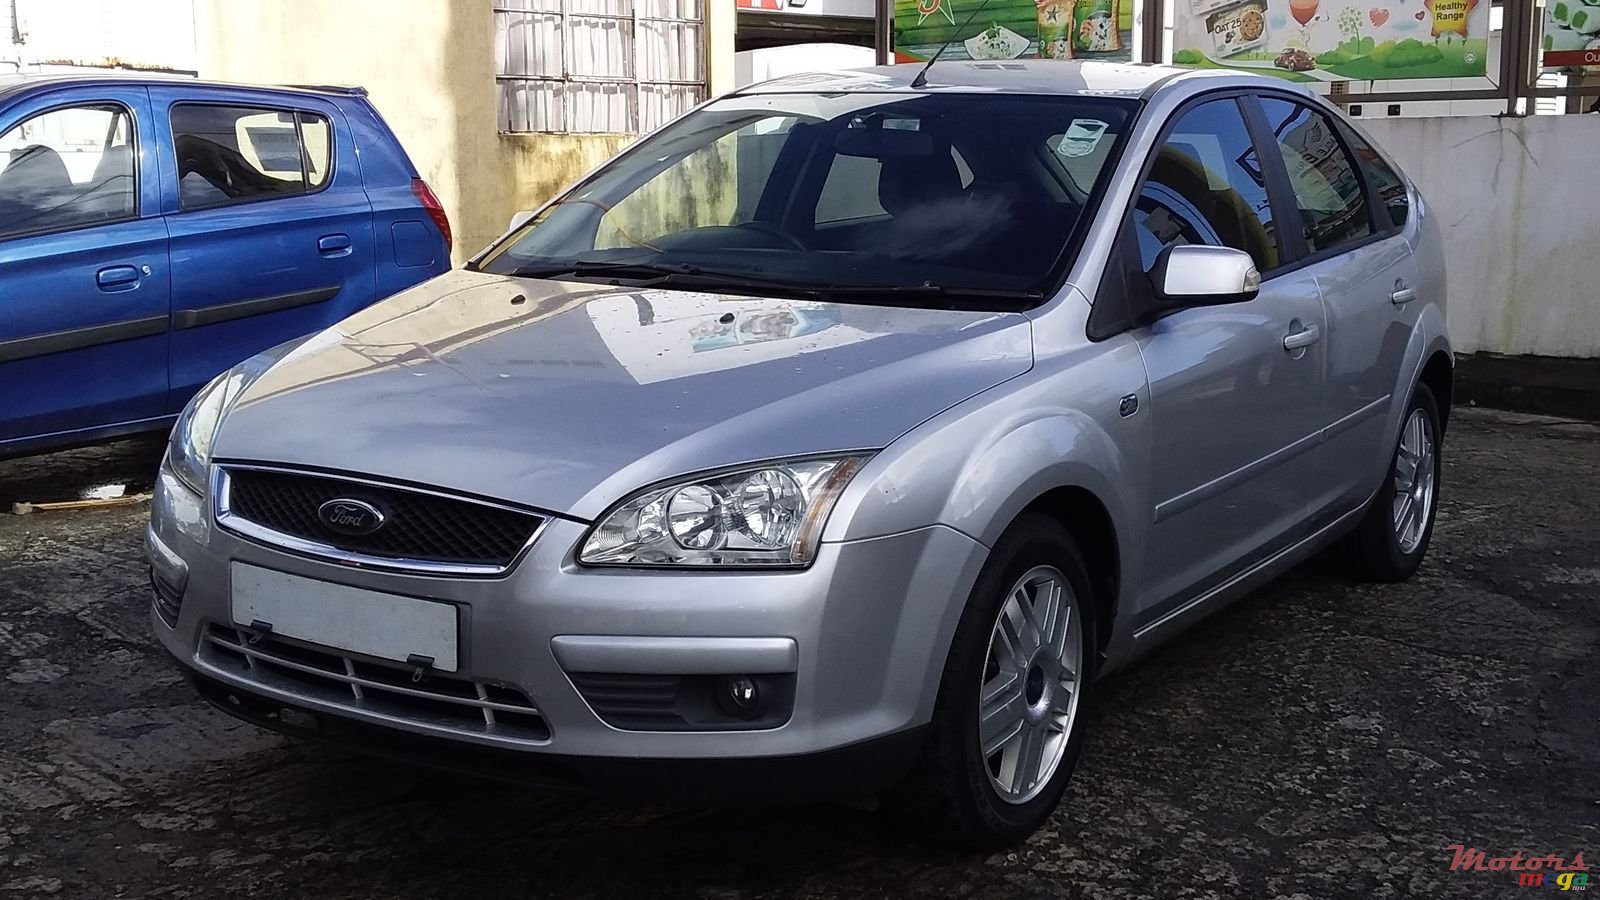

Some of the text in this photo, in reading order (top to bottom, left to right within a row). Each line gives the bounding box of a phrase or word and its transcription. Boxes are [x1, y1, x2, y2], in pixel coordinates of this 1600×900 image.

[1435, 2, 1467, 10] Healthy
[1436, 12, 1464, 21] Range
[330, 505, 365, 527] Ford
